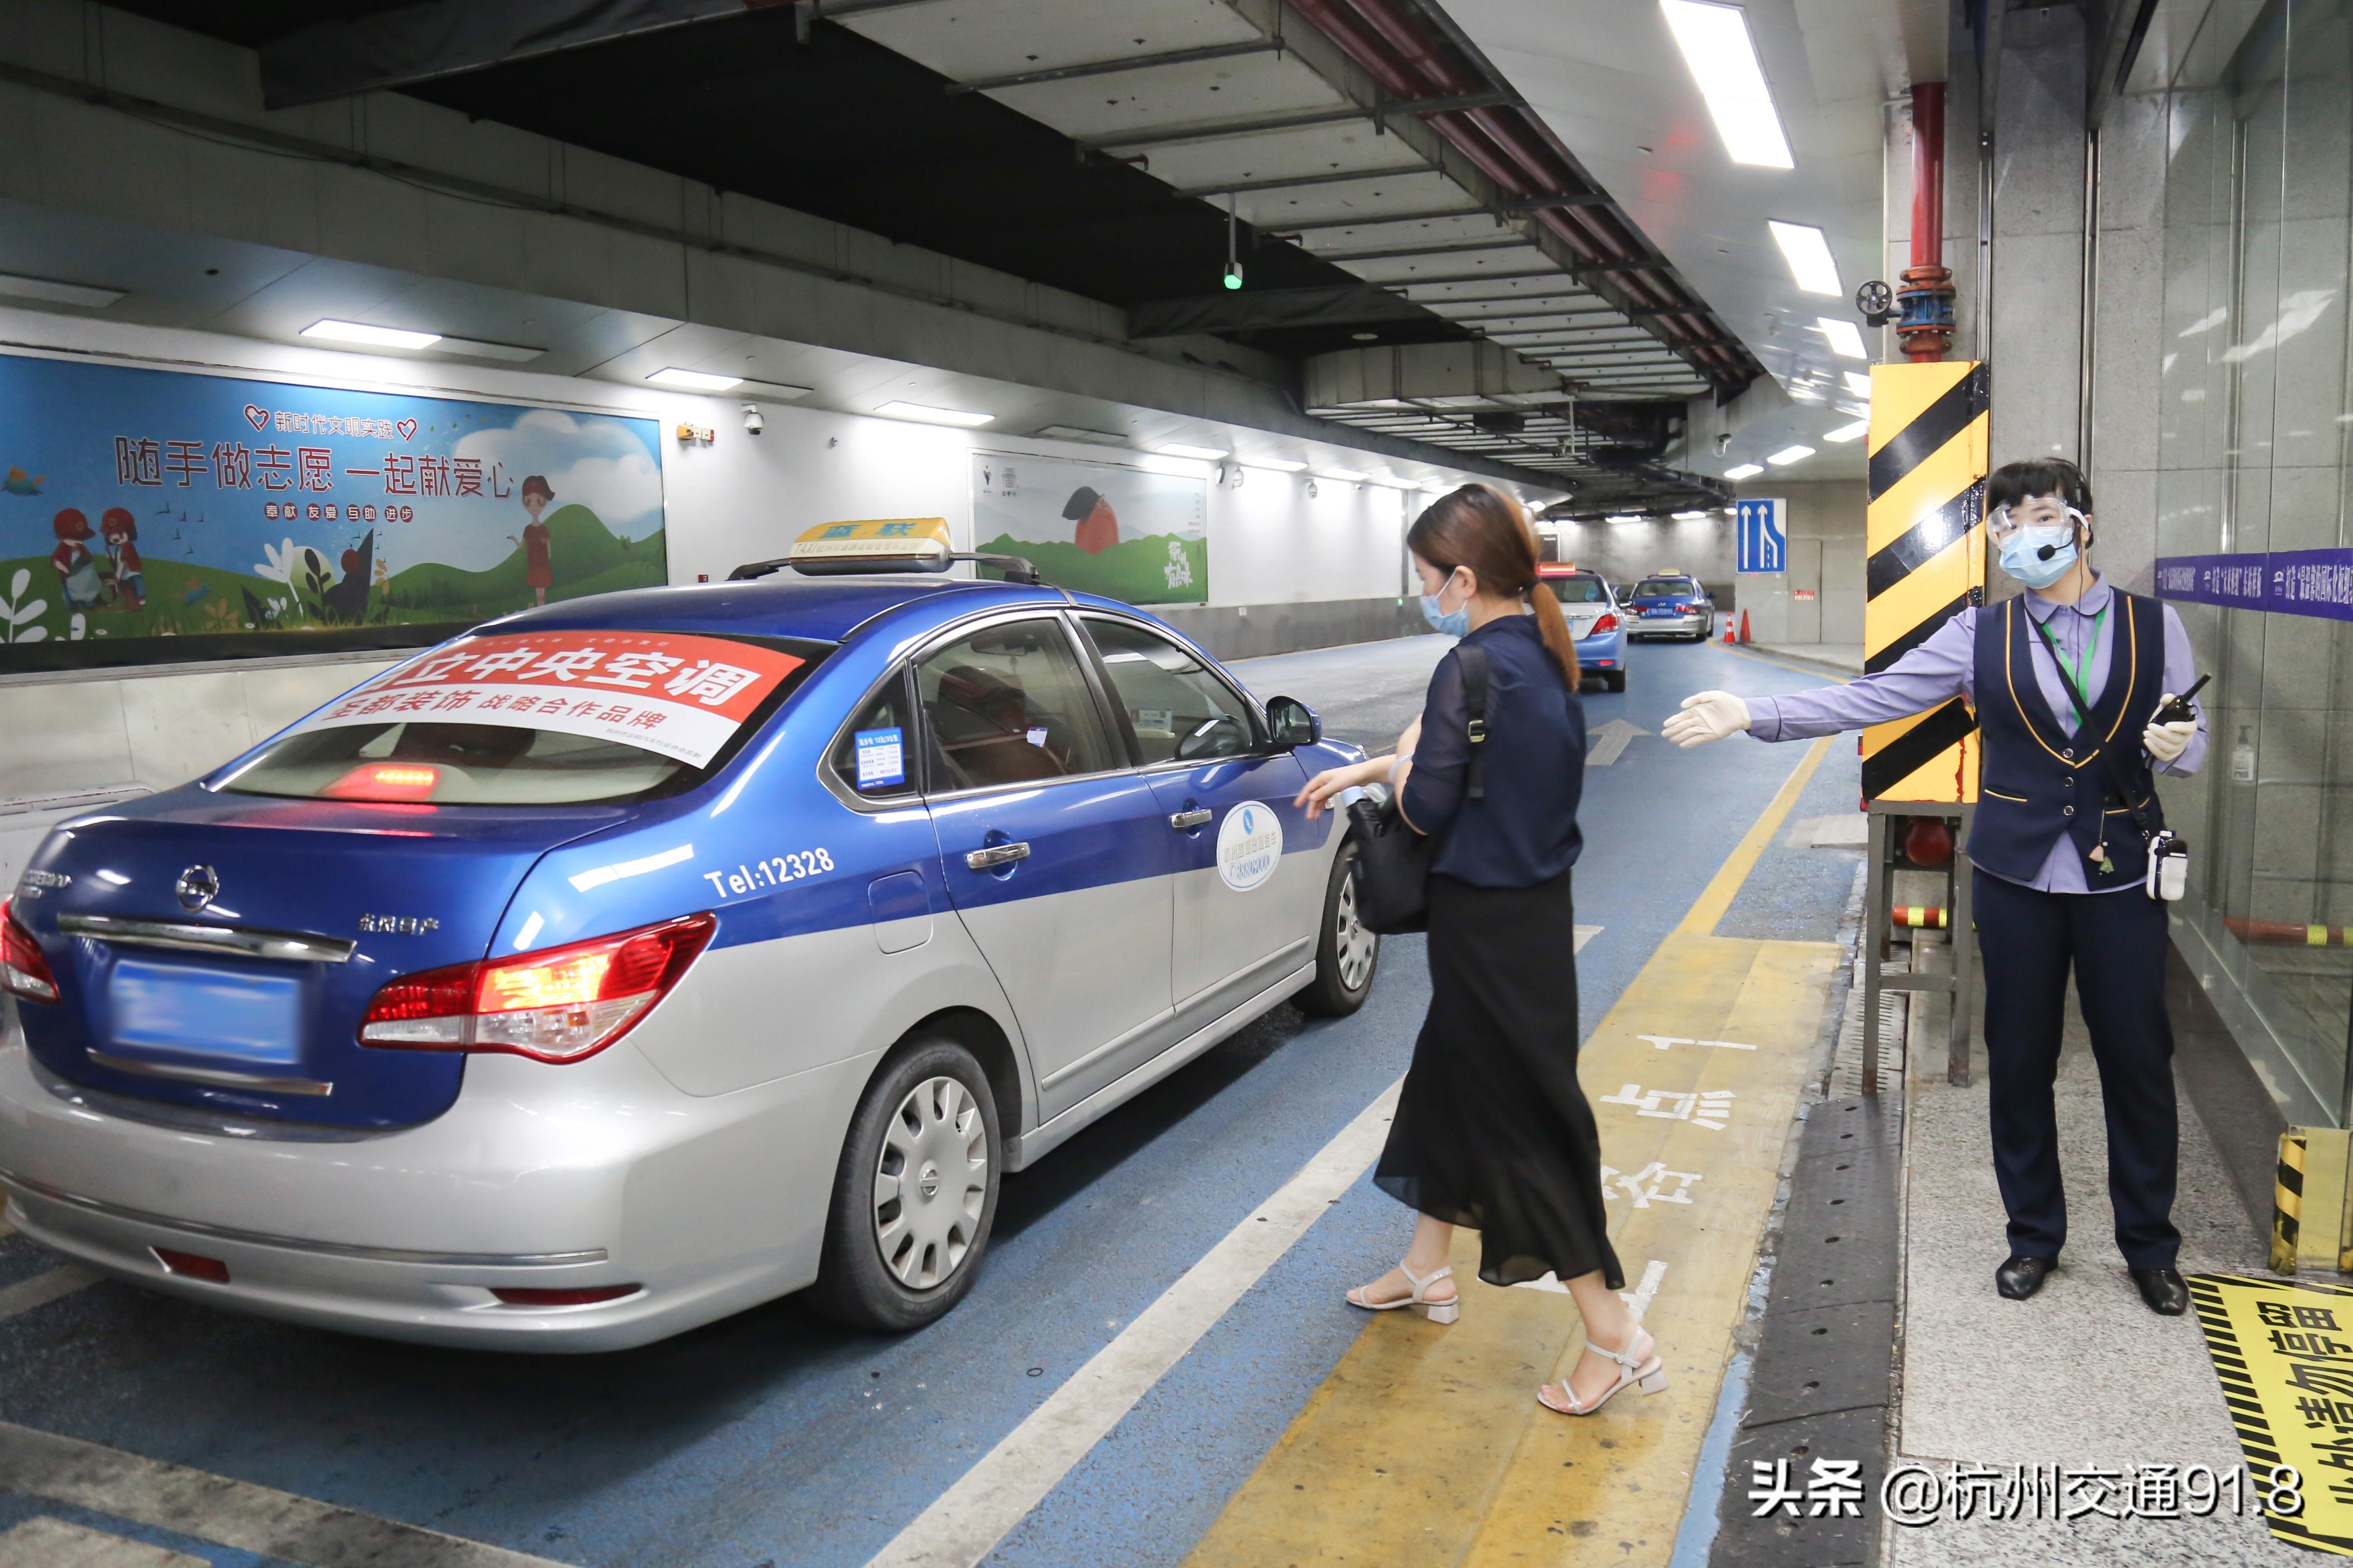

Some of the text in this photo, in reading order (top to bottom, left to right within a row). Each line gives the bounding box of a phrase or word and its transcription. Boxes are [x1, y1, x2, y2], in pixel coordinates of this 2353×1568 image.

[274, 409, 395, 441] 新时代文明实践
[115, 435, 515, 501] 随手做志愿 一起献爱心
[266, 504, 413, 522] 奉献 友爱 互助 进步
[477, 693, 668, 730] 战略合作品牌
[703, 846, 835, 900] Tel:12328
